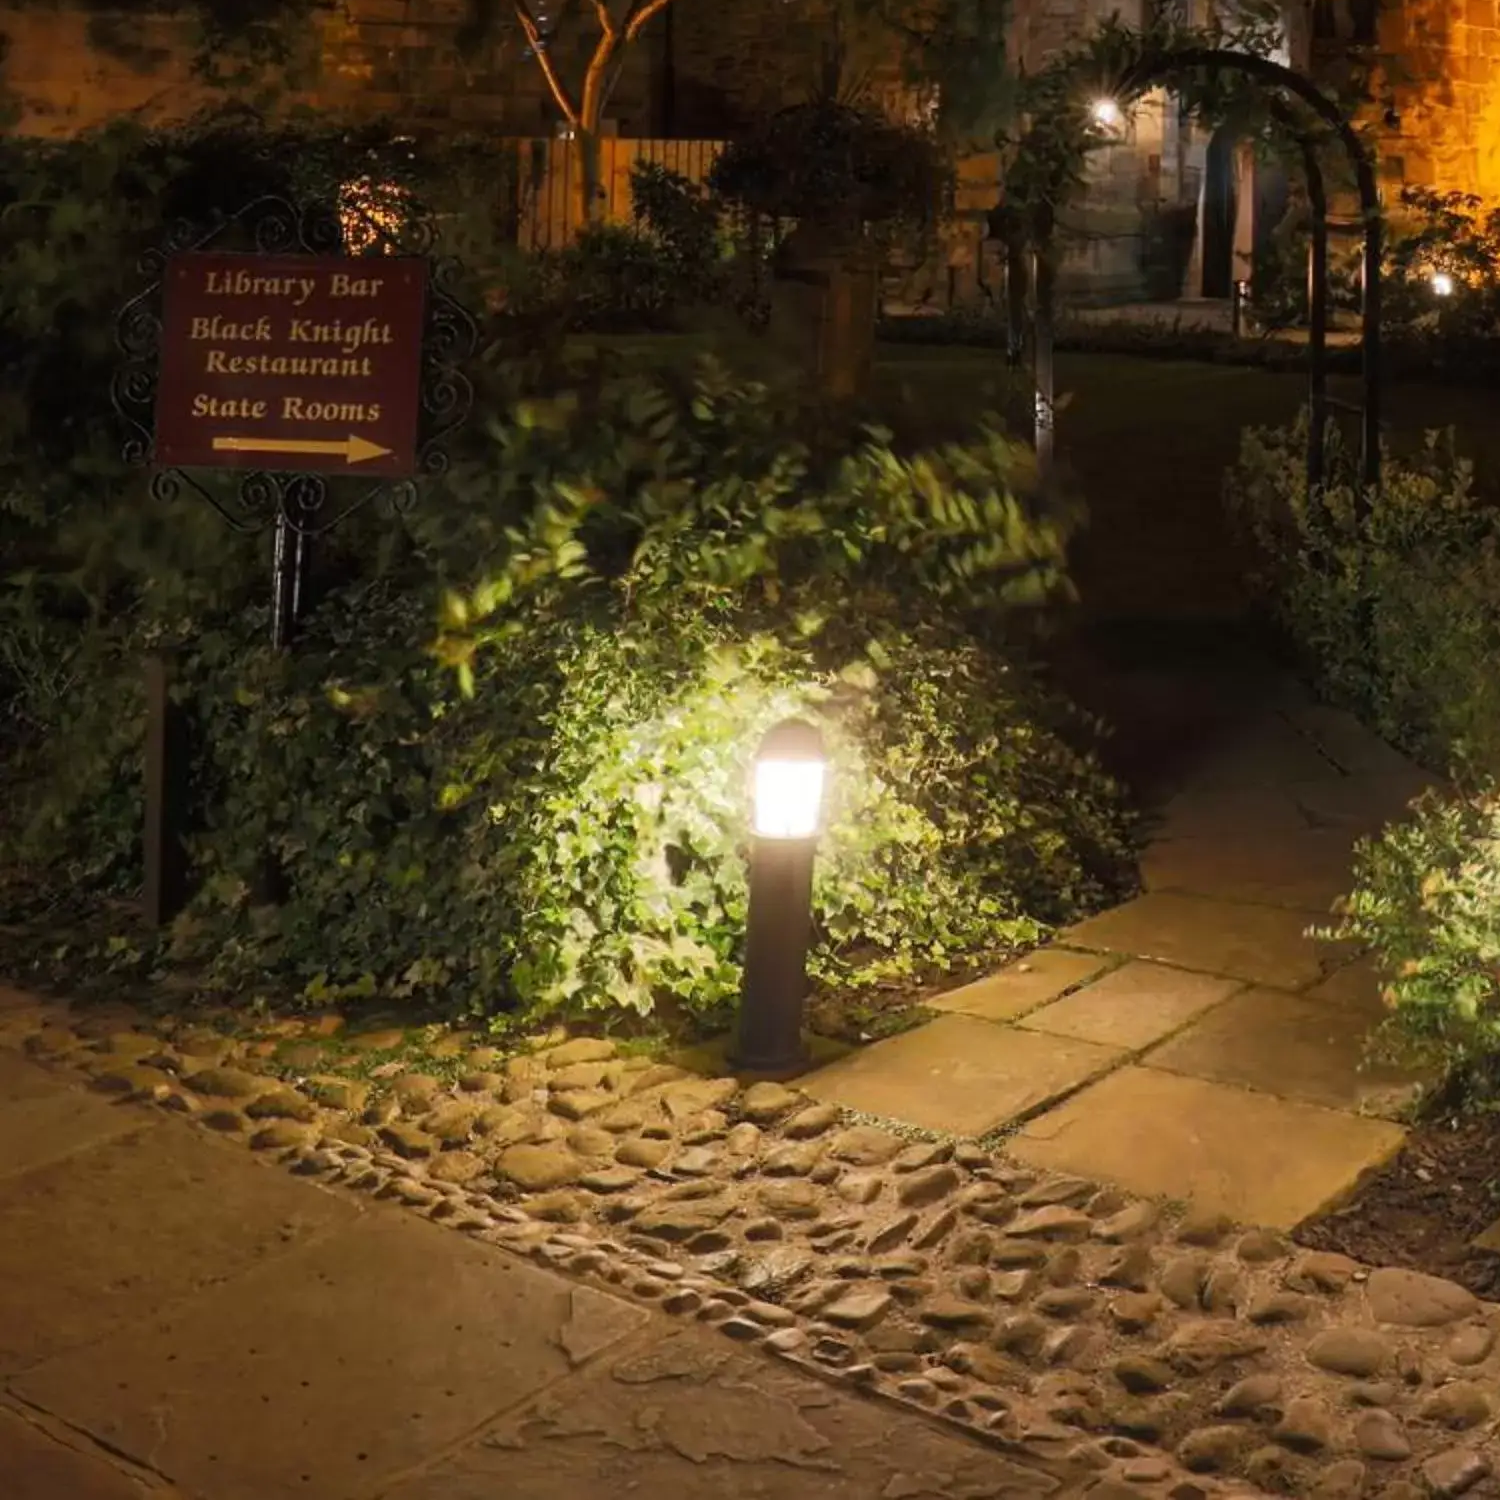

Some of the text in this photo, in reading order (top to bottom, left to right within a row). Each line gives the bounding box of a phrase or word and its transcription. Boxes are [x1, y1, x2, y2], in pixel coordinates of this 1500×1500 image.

[204, 268, 384, 306] Library Bar
[189, 314, 395, 353] Black Knight
[206, 350, 373, 377] Restaurant
[191, 393, 383, 423] State Rooms
